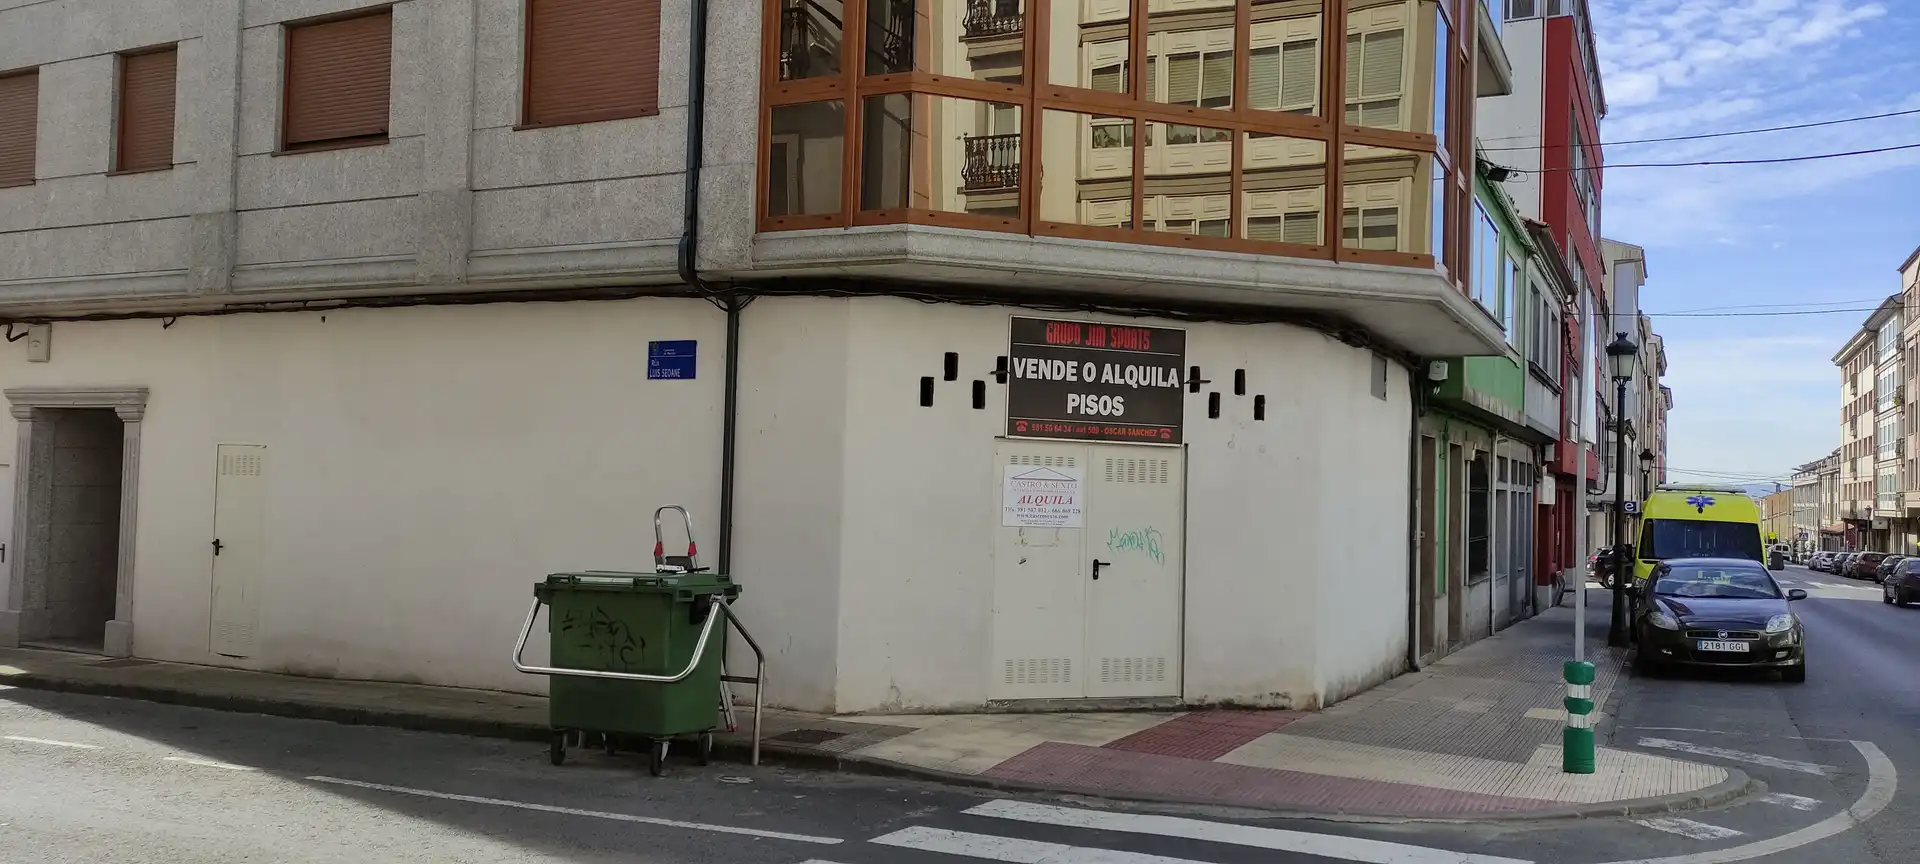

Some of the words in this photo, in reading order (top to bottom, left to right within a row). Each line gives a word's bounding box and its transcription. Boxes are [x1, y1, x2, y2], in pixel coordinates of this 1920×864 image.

[1046, 322, 1081, 344] GRUPO
[1086, 326, 1106, 347] JIM
[1110, 327, 1151, 350] SPORTS
[650, 368, 661, 377] LUIS
[661, 368, 681, 377] SEOANE
[1013, 357, 1078, 382] VENDE
[1083, 362, 1097, 383] O
[1101, 363, 1180, 389] ALQUILA
[1067, 393, 1126, 417] PISOS
[1104, 426, 1127, 437] OSCAR
[1127, 427, 1158, 438] SANCHEZ
[1011, 480, 1042, 489] CASTRO
[1051, 481, 1078, 490] SEXTO
[1017, 494, 1074, 507] ALQUILA
[1703, 641, 1726, 651] 2181
[1729, 642, 1746, 651] GGL
